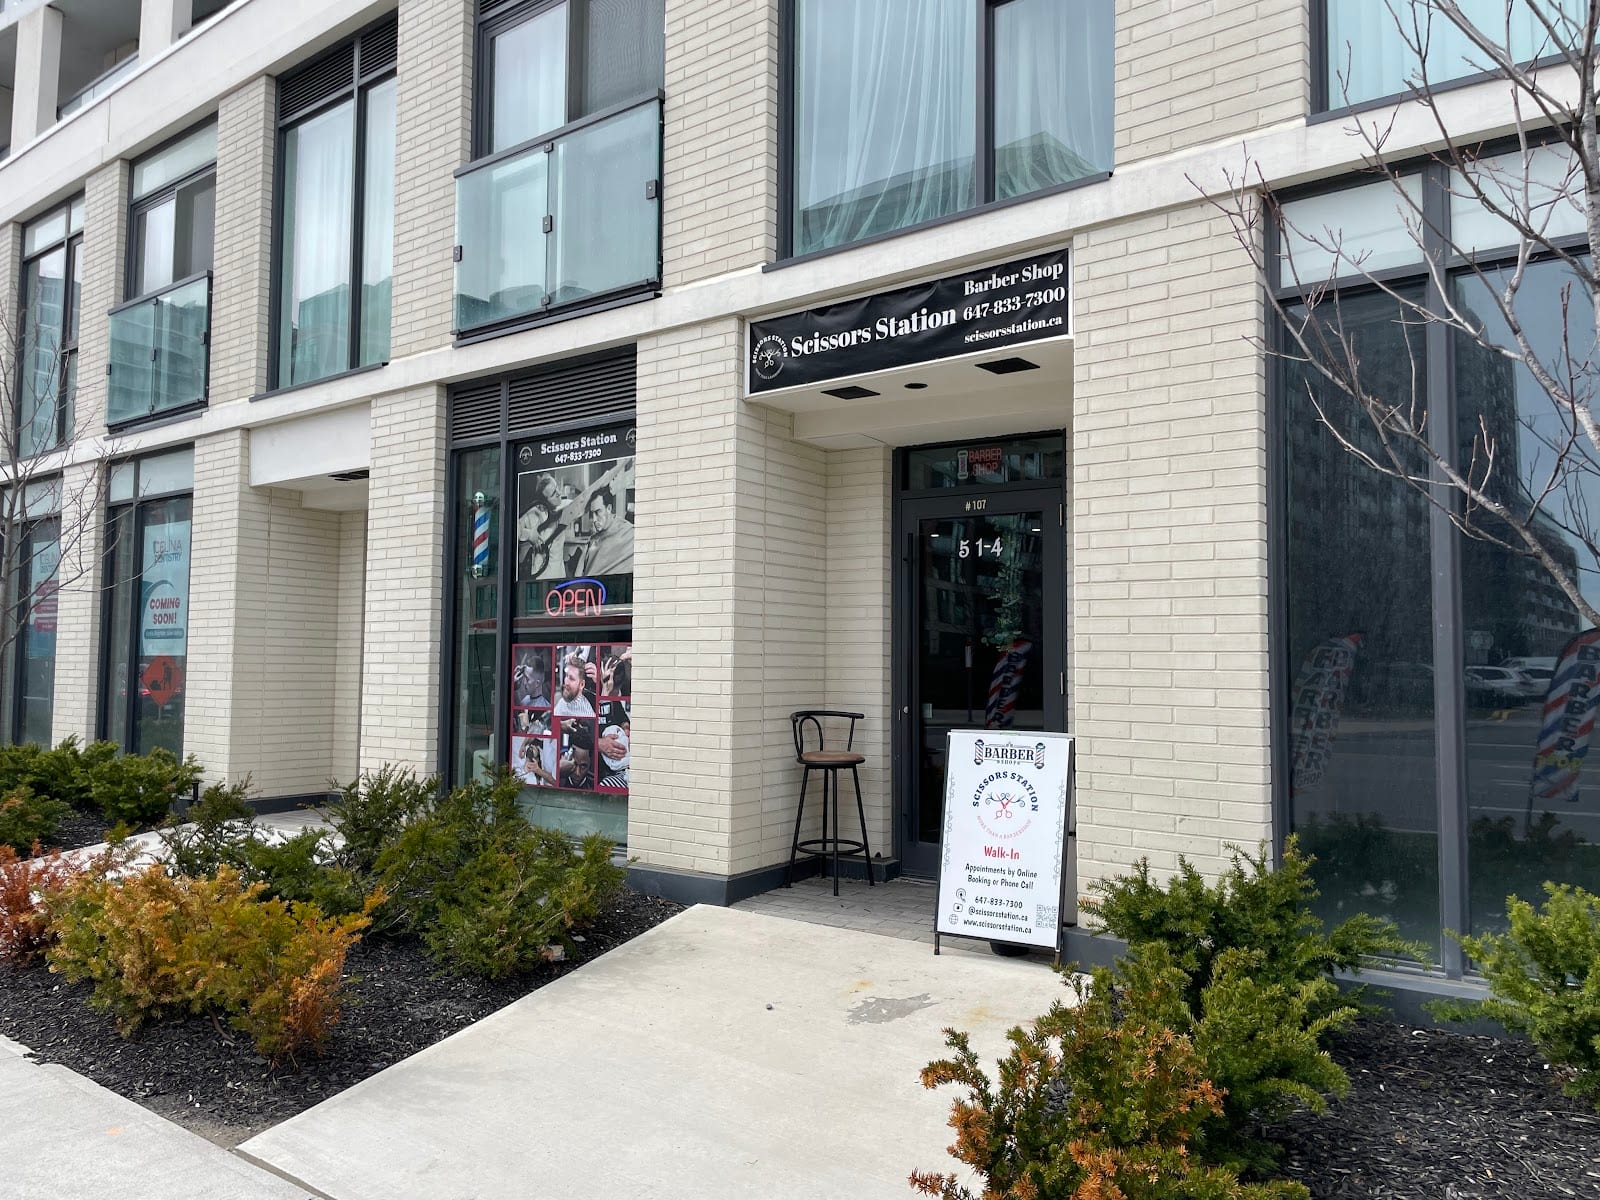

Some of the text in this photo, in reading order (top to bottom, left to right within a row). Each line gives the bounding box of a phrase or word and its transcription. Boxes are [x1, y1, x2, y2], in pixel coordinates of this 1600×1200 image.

[964, 261, 1064, 296] Barber Shop
[963, 286, 1066, 322] 647-833-7300
[791, 306, 957, 358] Scissors Station
[964, 315, 1063, 344] scissorsstation.ca
[541, 440, 579, 454] Scissors
[580, 433, 617, 448] Station
[555, 448, 602, 464] 647-833-7300
[969, 448, 1002, 463] BARBER
[972, 462, 998, 476] SHOP
[965, 499, 987, 511] #107
[149, 597, 180, 609] COMING
[545, 588, 602, 617] OPEN
[152, 612, 177, 625] SOON!
[984, 747, 1034, 760] BARBER
[972, 771, 1039, 812] SCISSORS STATION
[984, 845, 1020, 861] Walk-In
[965, 863, 1038, 878] Appointments by Online
[967, 874, 991, 886] Booking
[1000, 878, 1019, 888] Phone
[1020, 880, 1034, 889] Call
[974, 895, 1023, 909] 647-833-7300
[968, 906, 1028, 921] @scissorsstation.ca
[963, 919, 1032, 934] www.scissorsstation.ca
